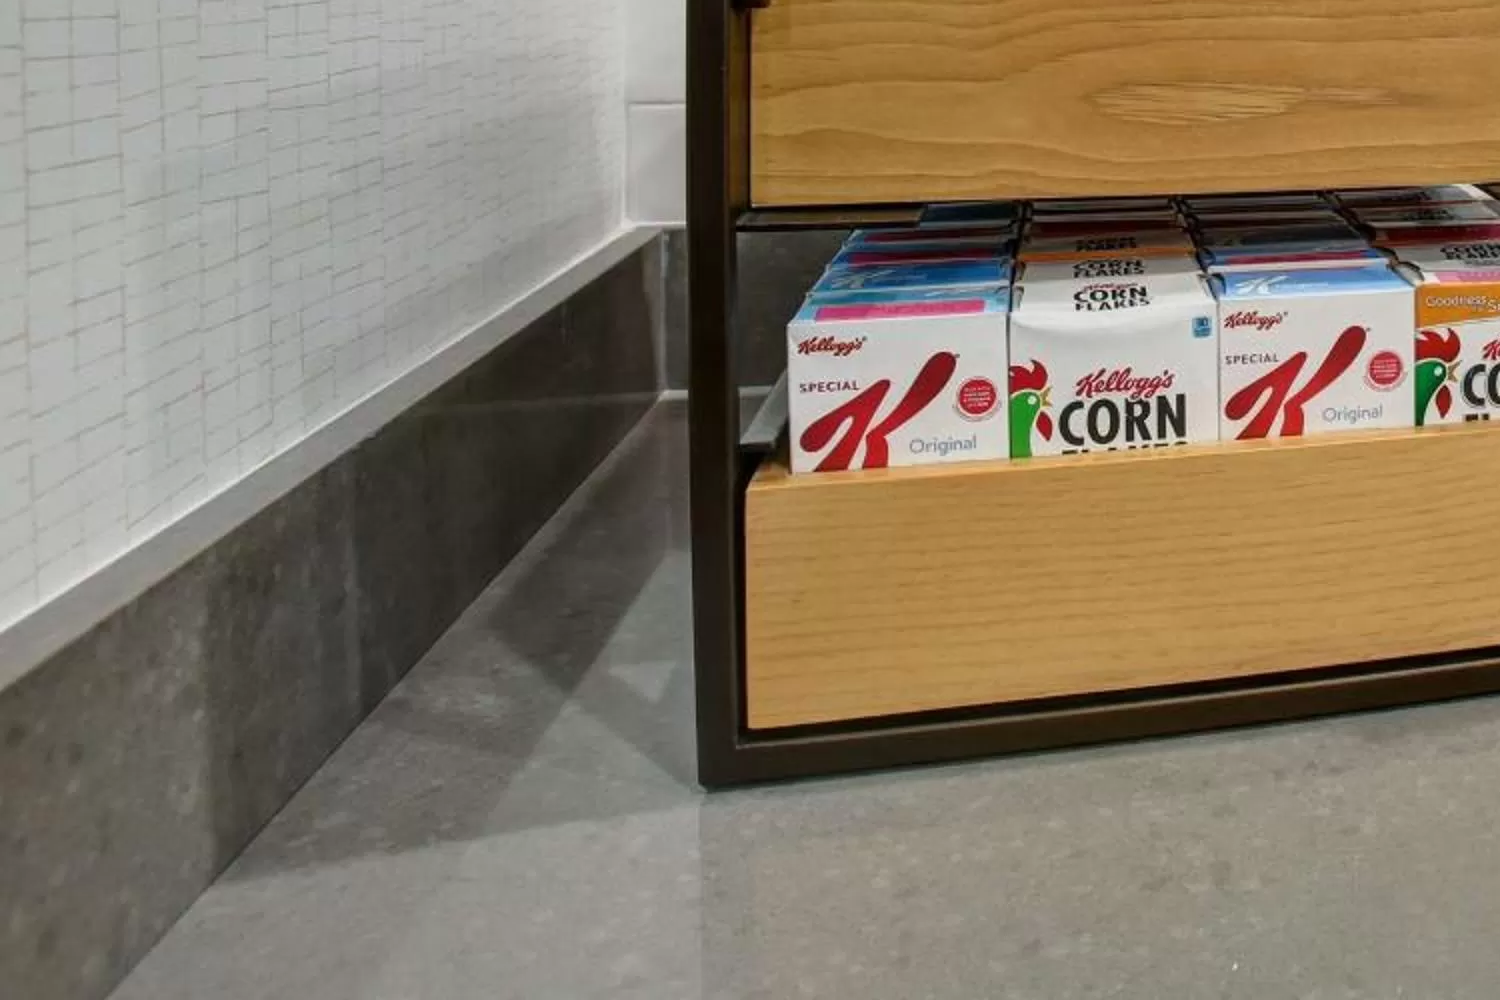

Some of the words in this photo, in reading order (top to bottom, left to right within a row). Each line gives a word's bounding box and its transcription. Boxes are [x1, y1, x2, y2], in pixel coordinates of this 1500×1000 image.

[1073, 285, 1147, 302] CORN
[1075, 299, 1151, 311] FLAKES
[1223, 311, 1286, 331] Kellogg's
[797, 335, 865, 357] Kellogg's
[1225, 352, 1280, 366] SPECIAL
[799, 380, 861, 393] SPECIAL
[1075, 367, 1176, 400] Kellogg's
[1225, 325, 1368, 441] K
[799, 351, 958, 473] K
[1058, 393, 1188, 447] CORN
[1321, 404, 1384, 425] Original
[908, 434, 978, 457] Original
